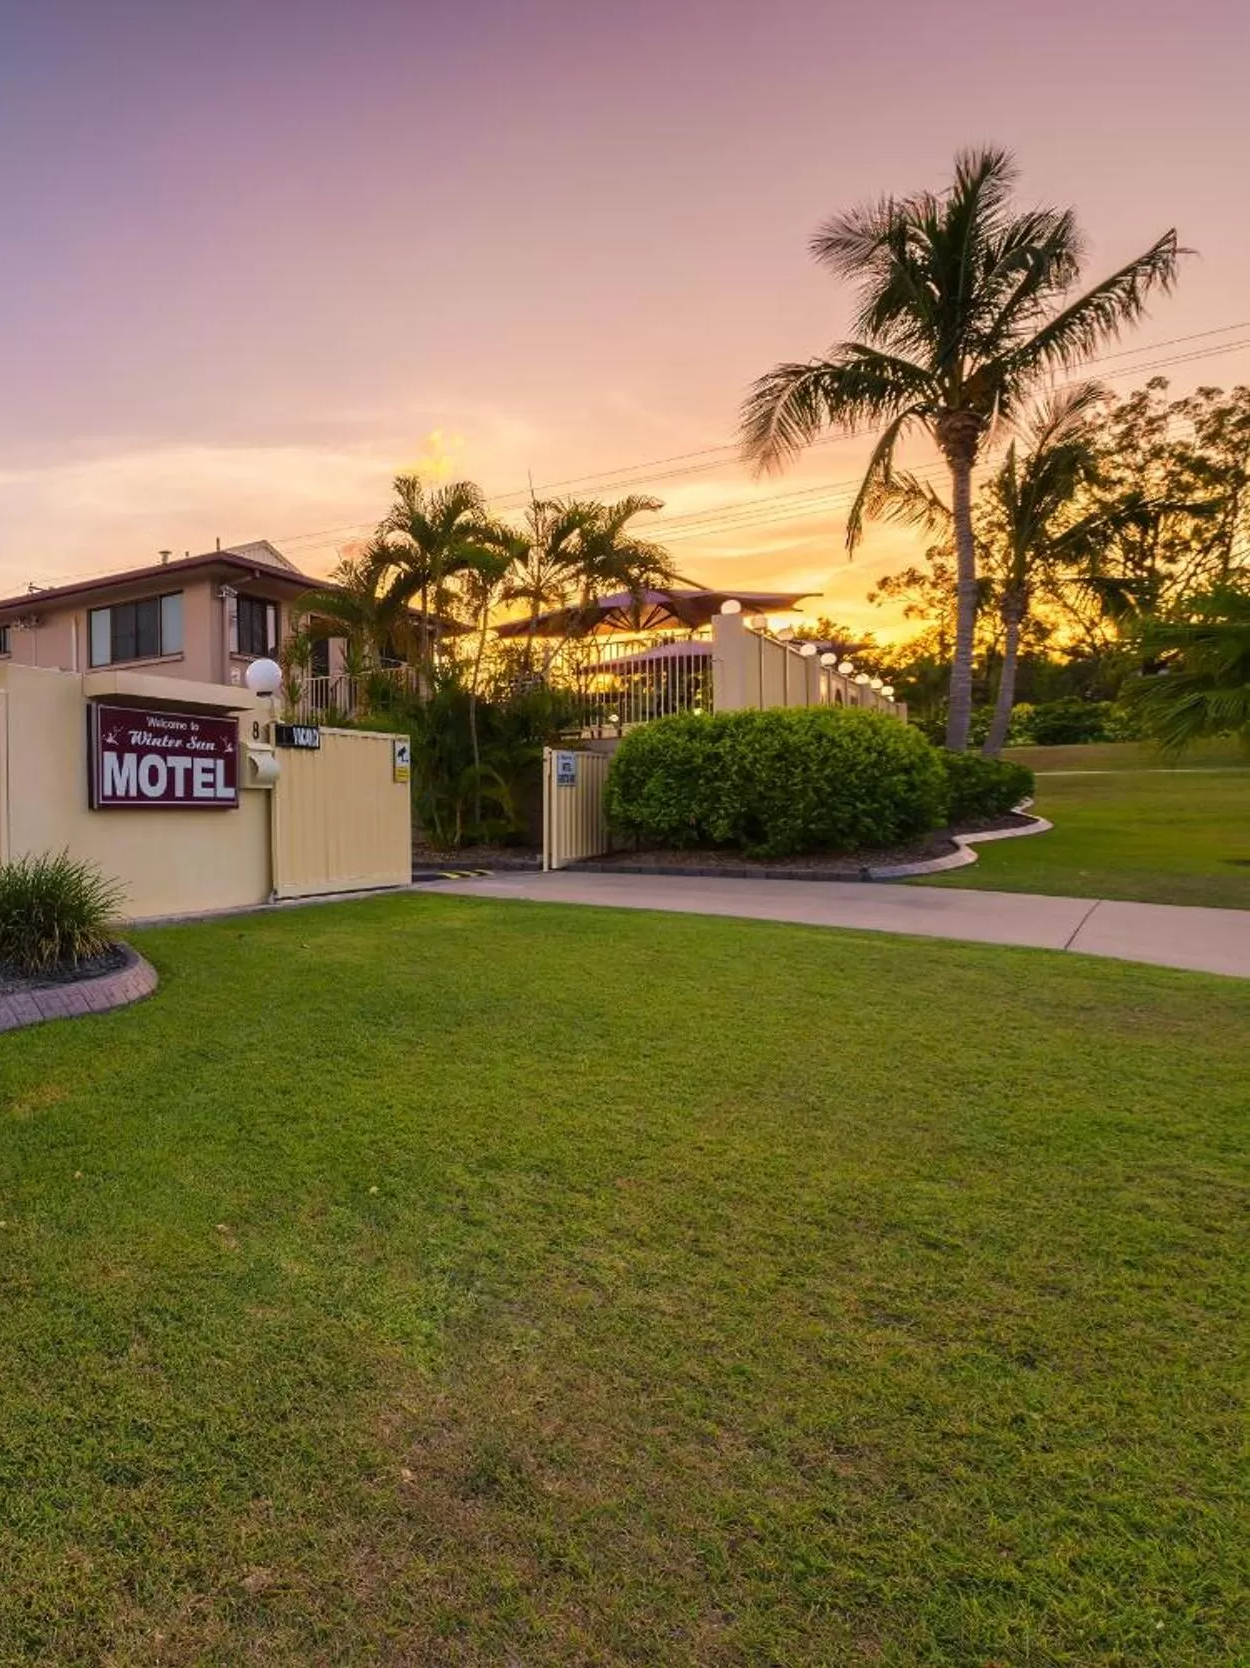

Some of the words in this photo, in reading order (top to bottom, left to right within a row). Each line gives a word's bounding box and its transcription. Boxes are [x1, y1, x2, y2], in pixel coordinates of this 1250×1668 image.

[147, 716, 187, 730] Welcome
[190, 721, 199, 731] to
[252, 721, 260, 740] 8
[128, 730, 183, 748] Winter
[186, 735, 216, 751] Sun
[103, 751, 235, 798] MOTEL
